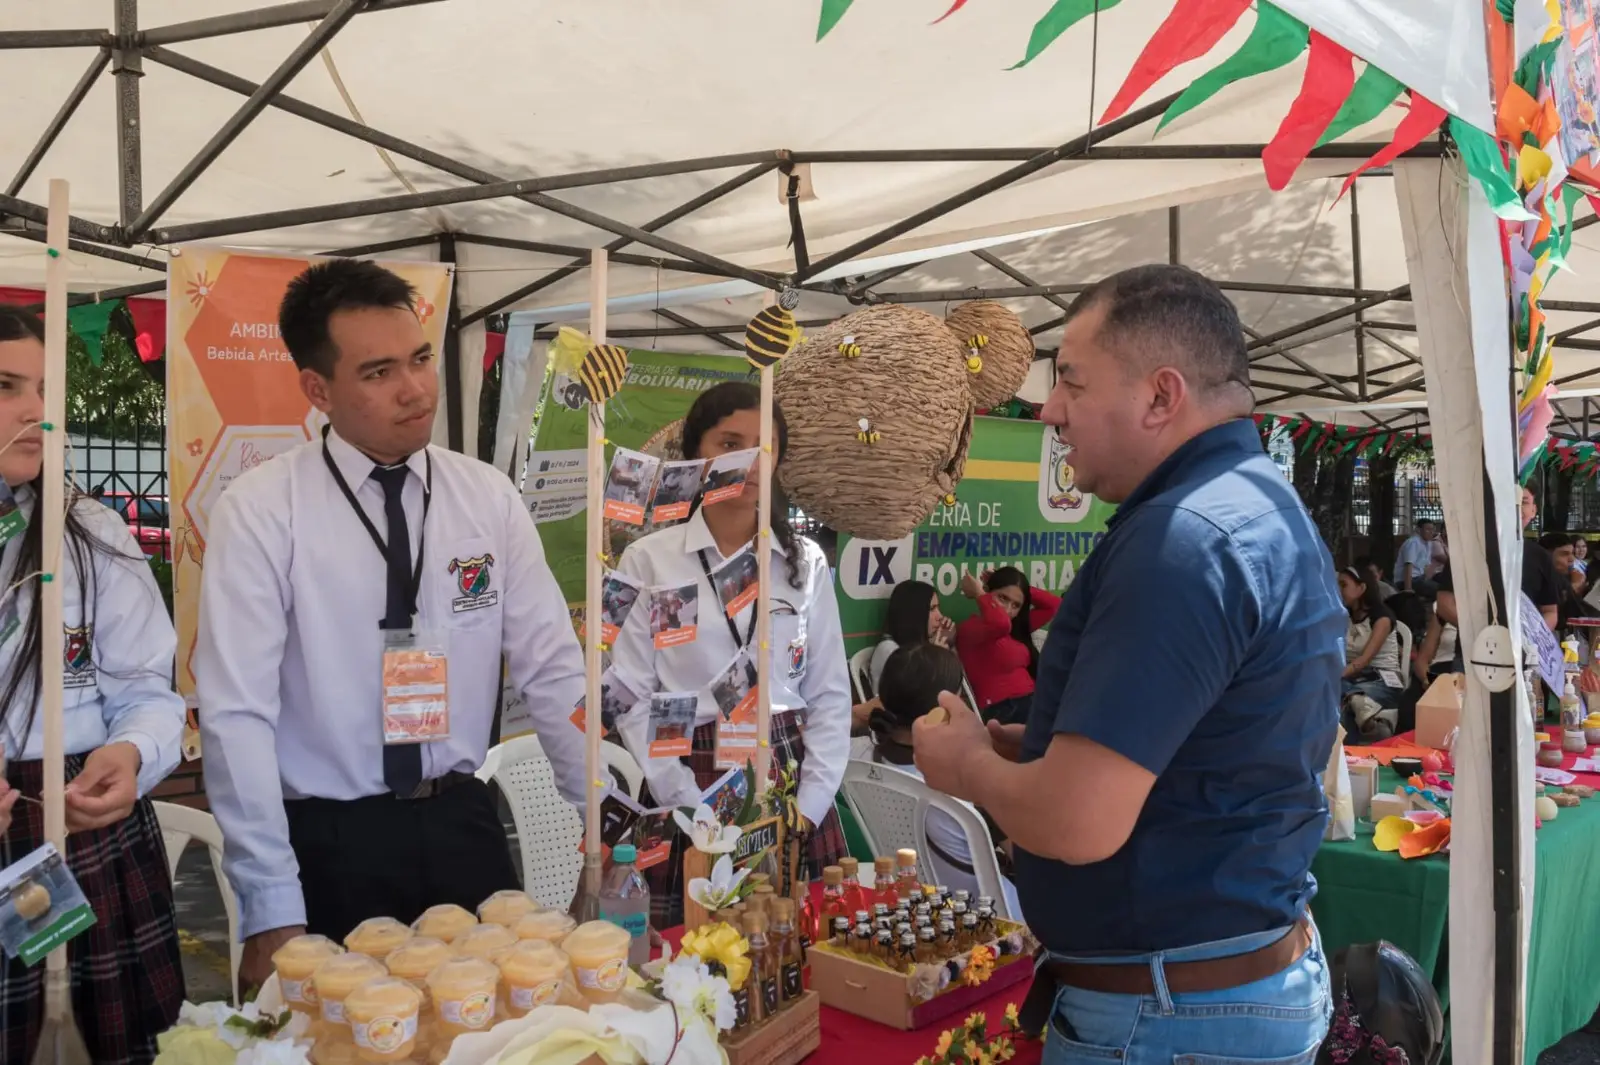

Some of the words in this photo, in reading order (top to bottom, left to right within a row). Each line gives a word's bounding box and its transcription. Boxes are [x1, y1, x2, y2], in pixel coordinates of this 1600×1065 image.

[207, 346, 254, 360] Bebida
[634, 364, 661, 375] FERIA
[663, 365, 676, 375] DE
[978, 502, 1001, 527] DE
[858, 546, 898, 586] IX
